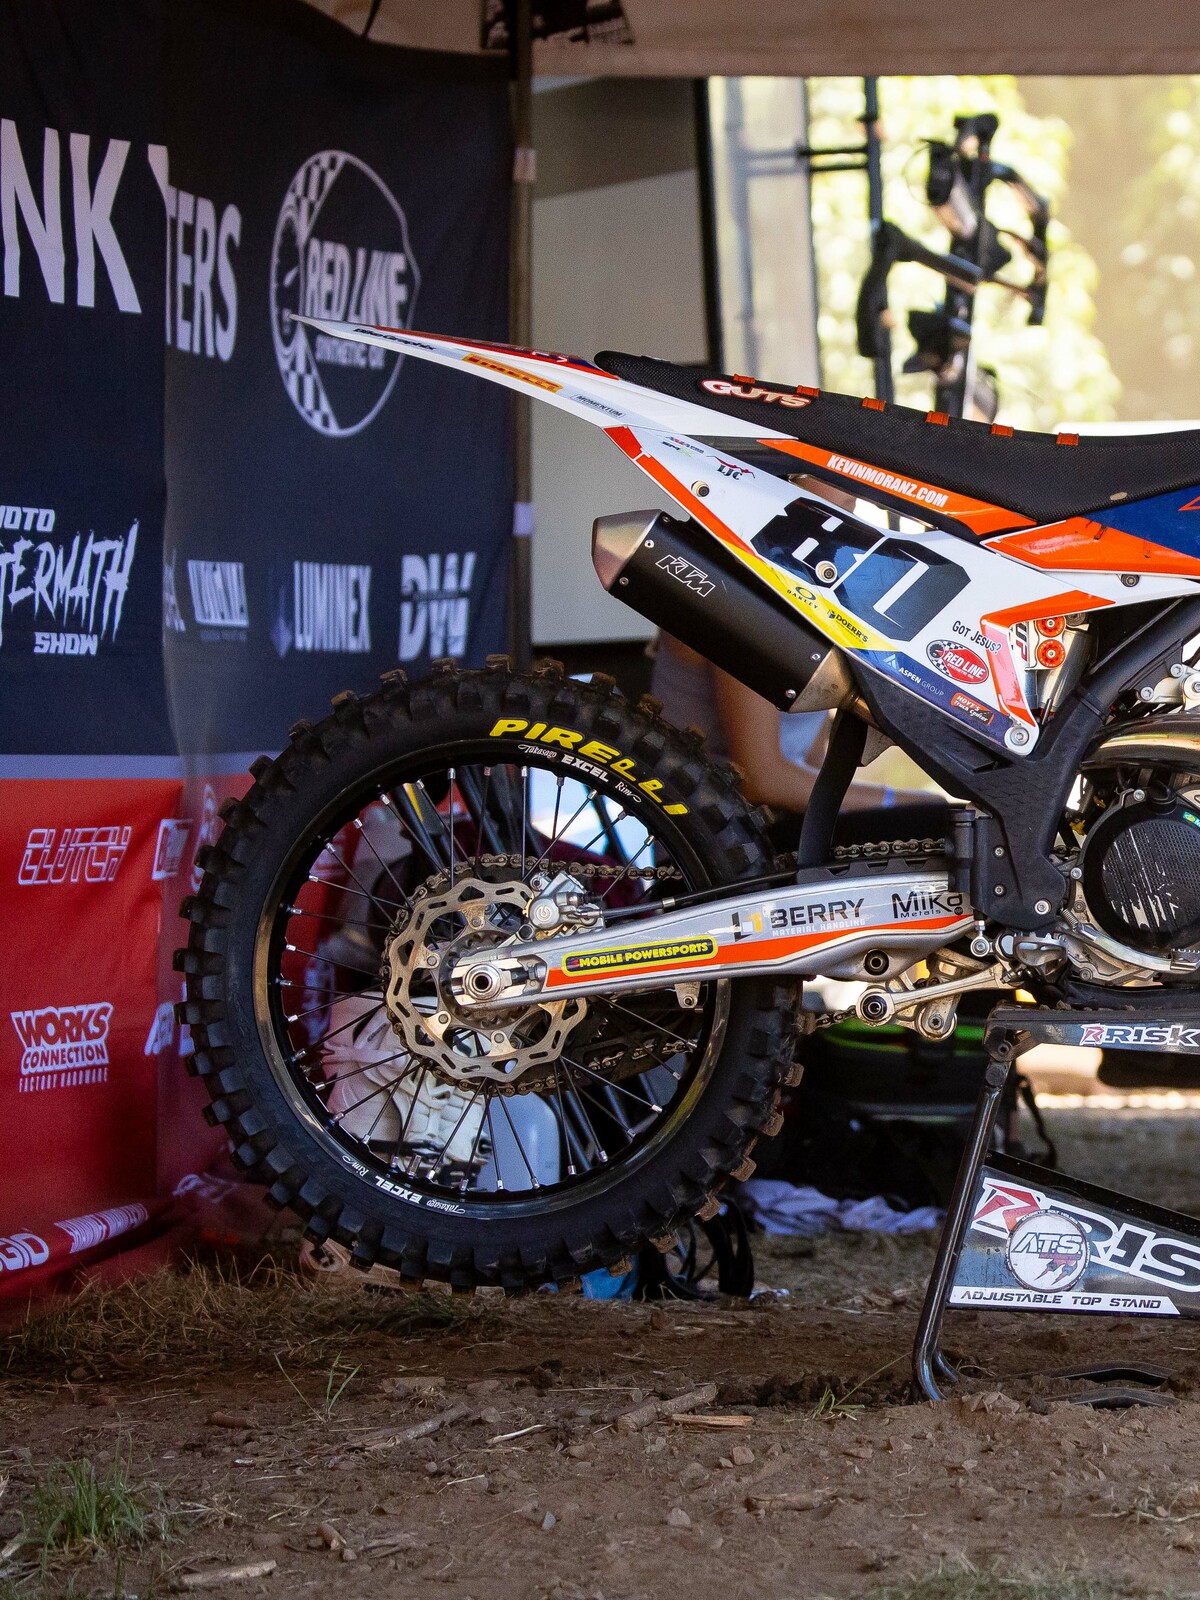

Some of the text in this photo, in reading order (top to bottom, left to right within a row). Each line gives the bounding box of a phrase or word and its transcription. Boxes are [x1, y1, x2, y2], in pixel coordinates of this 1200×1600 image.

[305, 237, 350, 321] RED
[577, 394, 623, 418] MOMENTUM
[701, 379, 812, 409] GUTS
[826, 454, 949, 508] KEVINMORANZ.COM
[655, 554, 716, 598] KTM
[787, 589, 818, 610] OAKLEY
[836, 614, 869, 643] DOERR'S
[33, 631, 99, 657] SHOW
[943, 650, 987, 680] RED LINE
[898, 667, 945, 697] ASPEN GROUP
[488, 718, 690, 816] PIRELLI
[560, 753, 610, 783] EXCEL
[772, 918, 867, 938] MATERIAL HANDLING
[900, 908, 942, 919] Metals
[578, 941, 709, 968] MOBILE POWERSPORTS
[12, 1002, 114, 1048] WORKS
[21, 1041, 109, 1074] CONNECTION
[374, 1174, 423, 1205] EXCEL
[960, 1290, 1162, 1310] ADJUSTABLE TOP STAND
